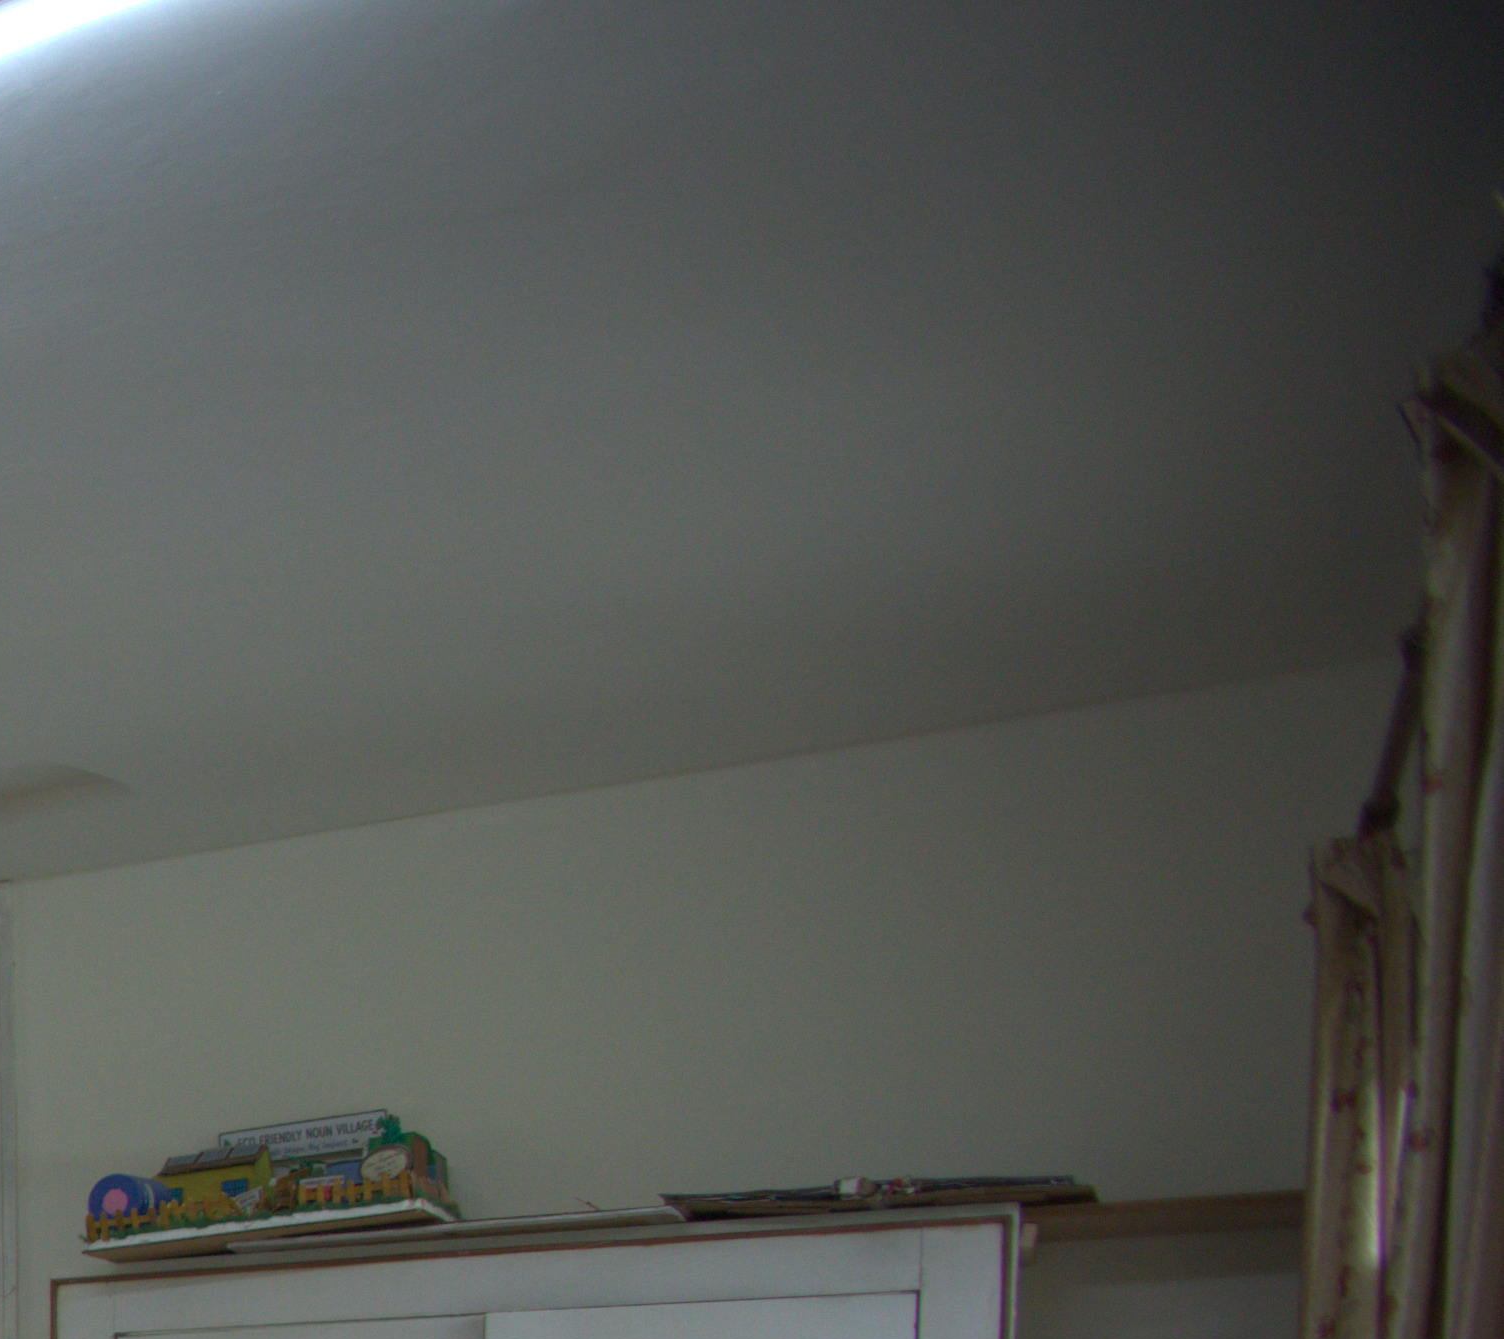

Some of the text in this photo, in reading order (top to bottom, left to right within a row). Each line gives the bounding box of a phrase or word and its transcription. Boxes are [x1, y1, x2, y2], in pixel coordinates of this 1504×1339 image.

[259, 1130, 302, 1146] FRIENDLY
[306, 1125, 333, 1139] NOUN
[336, 1119, 374, 1135] VILLAGE
